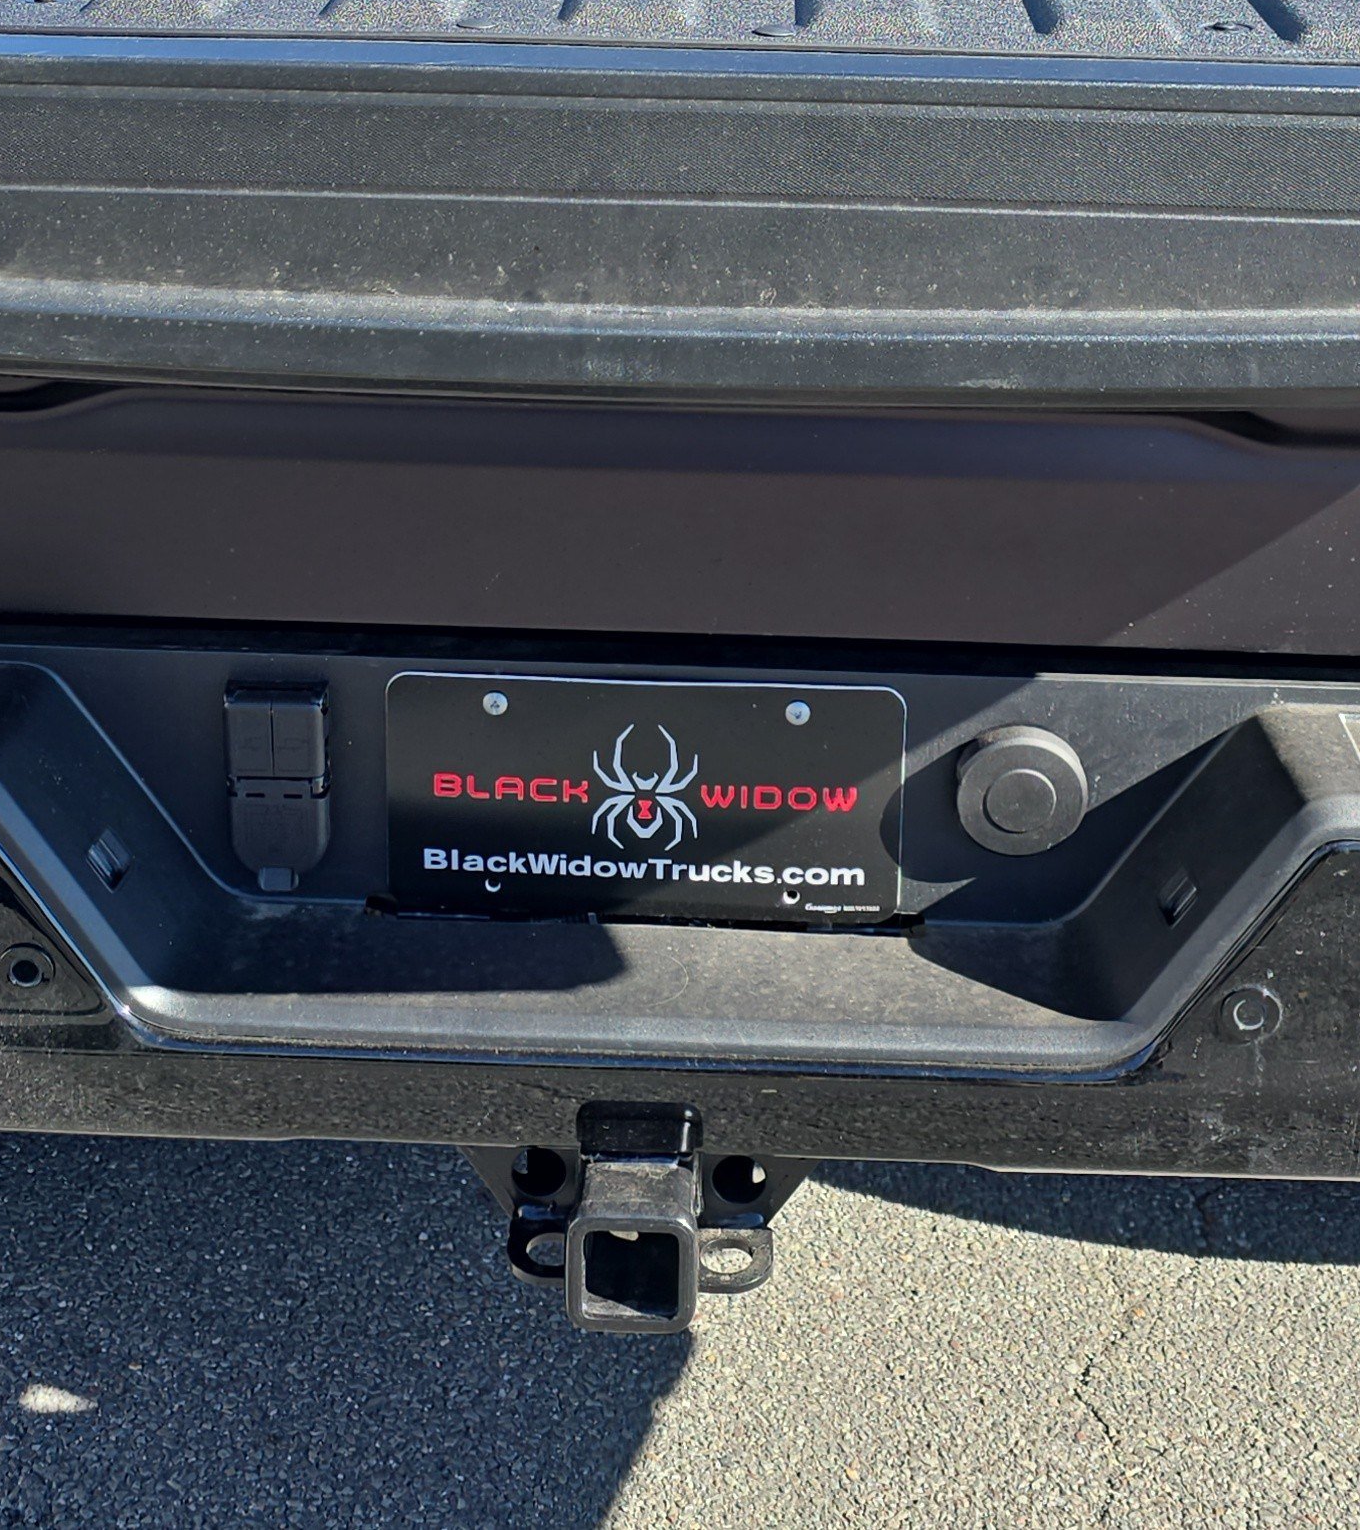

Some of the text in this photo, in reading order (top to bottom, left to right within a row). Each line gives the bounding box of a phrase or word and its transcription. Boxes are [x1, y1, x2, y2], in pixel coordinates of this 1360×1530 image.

[433, 773, 858, 813] BLACK WIDOW
[423, 847, 865, 886] BlackWidowTrucks.com
